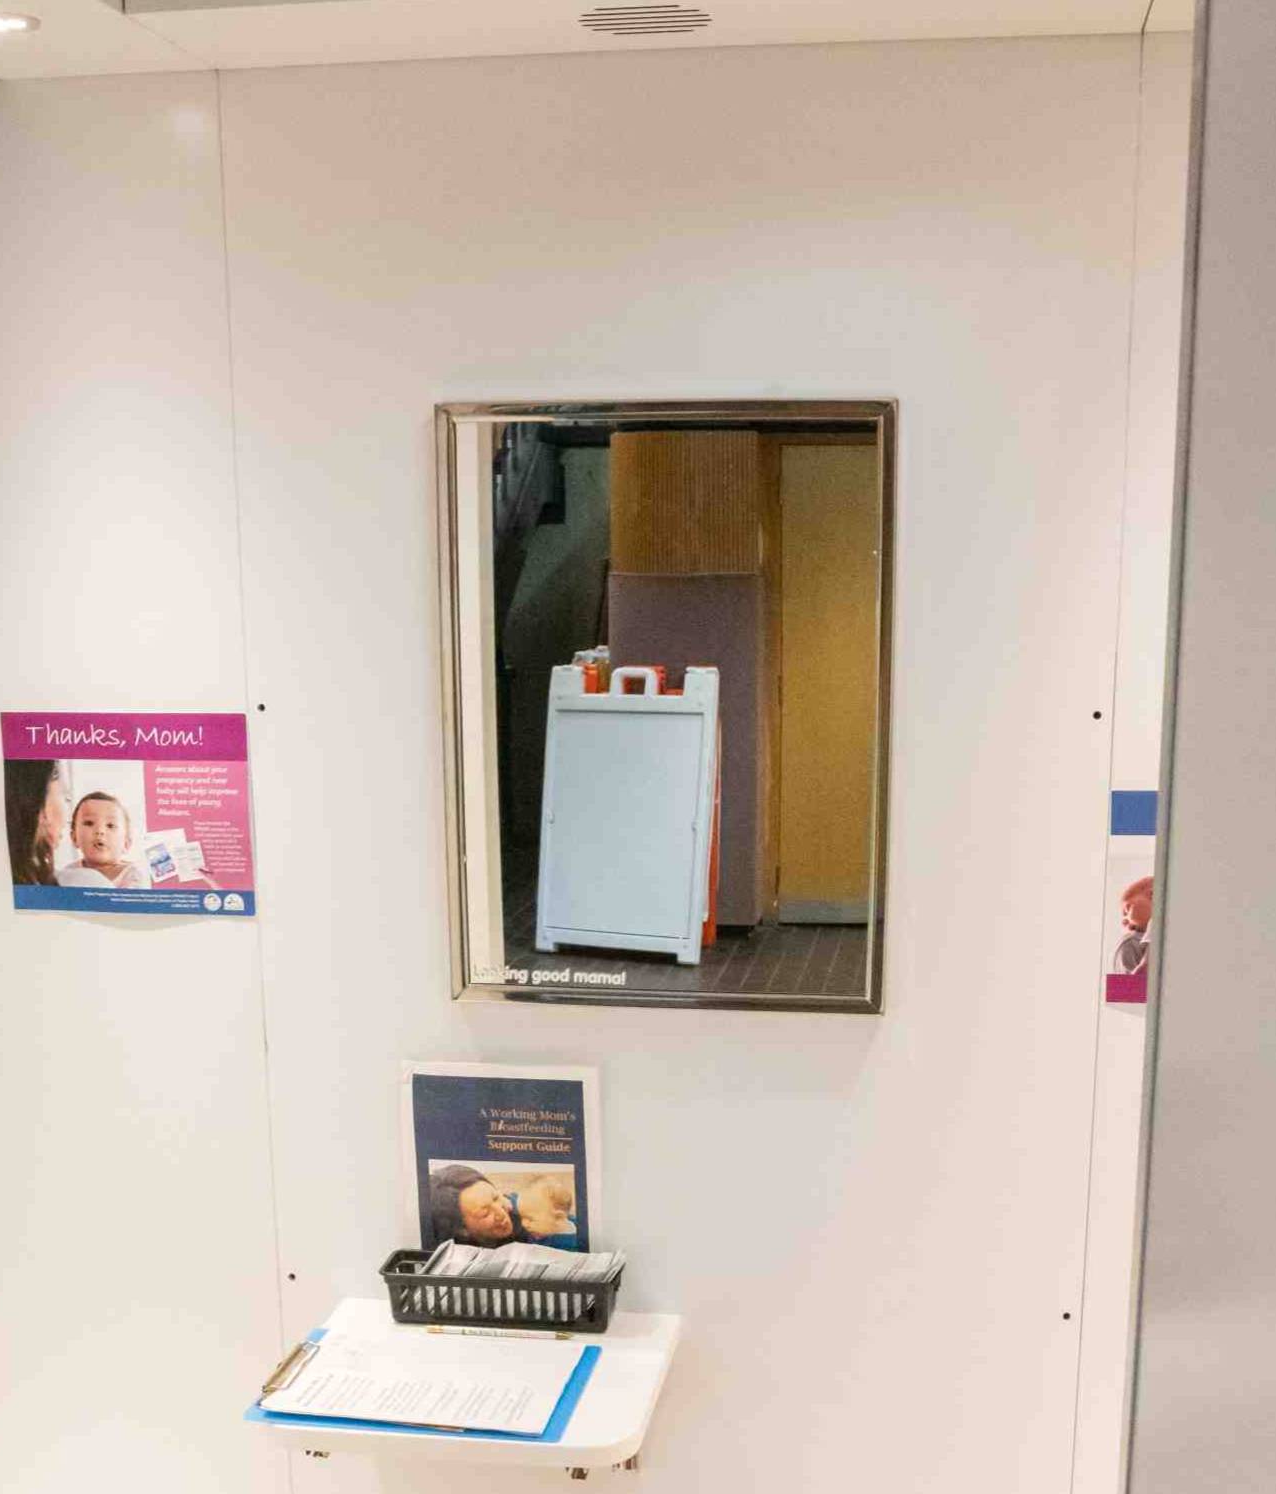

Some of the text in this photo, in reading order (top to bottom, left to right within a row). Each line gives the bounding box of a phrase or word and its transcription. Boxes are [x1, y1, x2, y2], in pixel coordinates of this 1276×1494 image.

[25, 724, 203, 748] Thanks, Mom!
[531, 968, 570, 985] good
[574, 970, 627, 986] mama!
[489, 1107, 538, 1122] Working
[539, 1109, 577, 1122] Mom's
[488, 1140, 572, 1153] Support Guide
